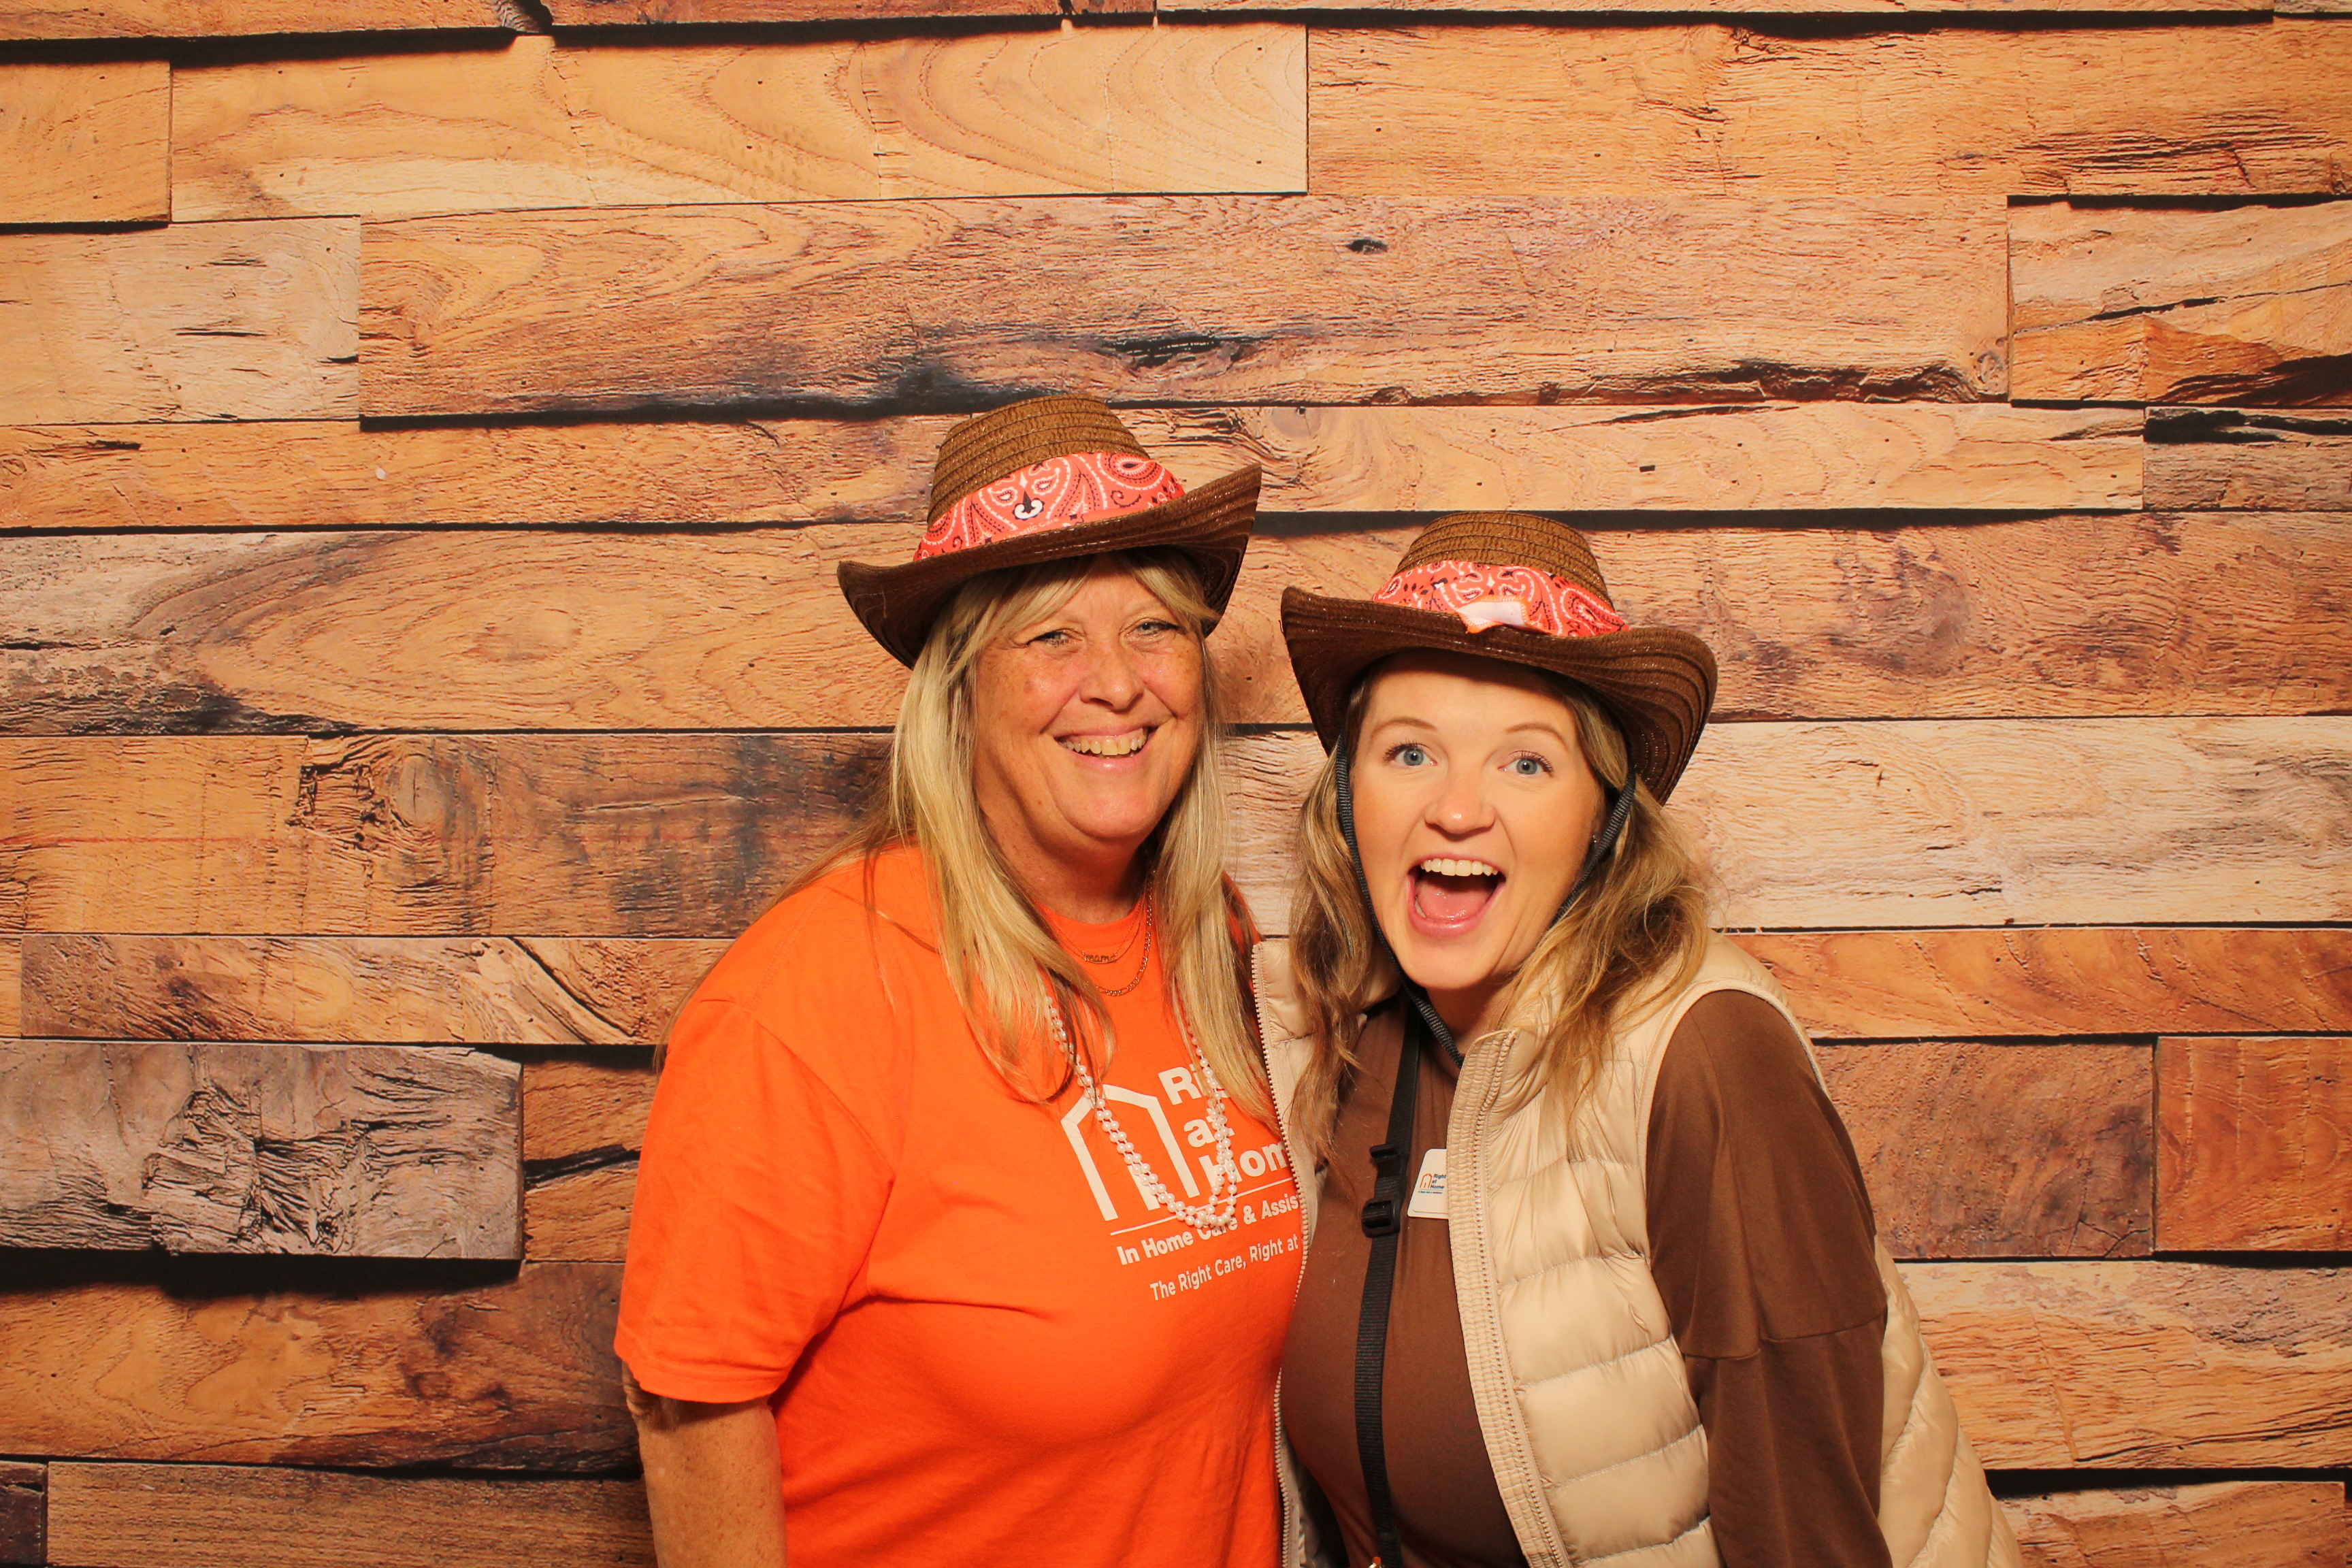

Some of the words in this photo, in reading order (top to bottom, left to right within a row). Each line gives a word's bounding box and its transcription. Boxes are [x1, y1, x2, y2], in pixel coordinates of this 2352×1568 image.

[1003, 522, 1038, 540] estic
[1039, 518, 1059, 527] Care
[1198, 1141, 1287, 1190] Hom
[1116, 1245, 1141, 1266] In
[1141, 1230, 1194, 1259] Home
[1196, 1216, 1238, 1241] Care
[1243, 1205, 1257, 1225] &
[1261, 1193, 1300, 1220] Assis
[1149, 1280, 1176, 1301] The
[1177, 1264, 1212, 1292] Right
[1214, 1254, 1247, 1277] Care,
[1249, 1238, 1284, 1264] Right
[1286, 1233, 1299, 1252] at
